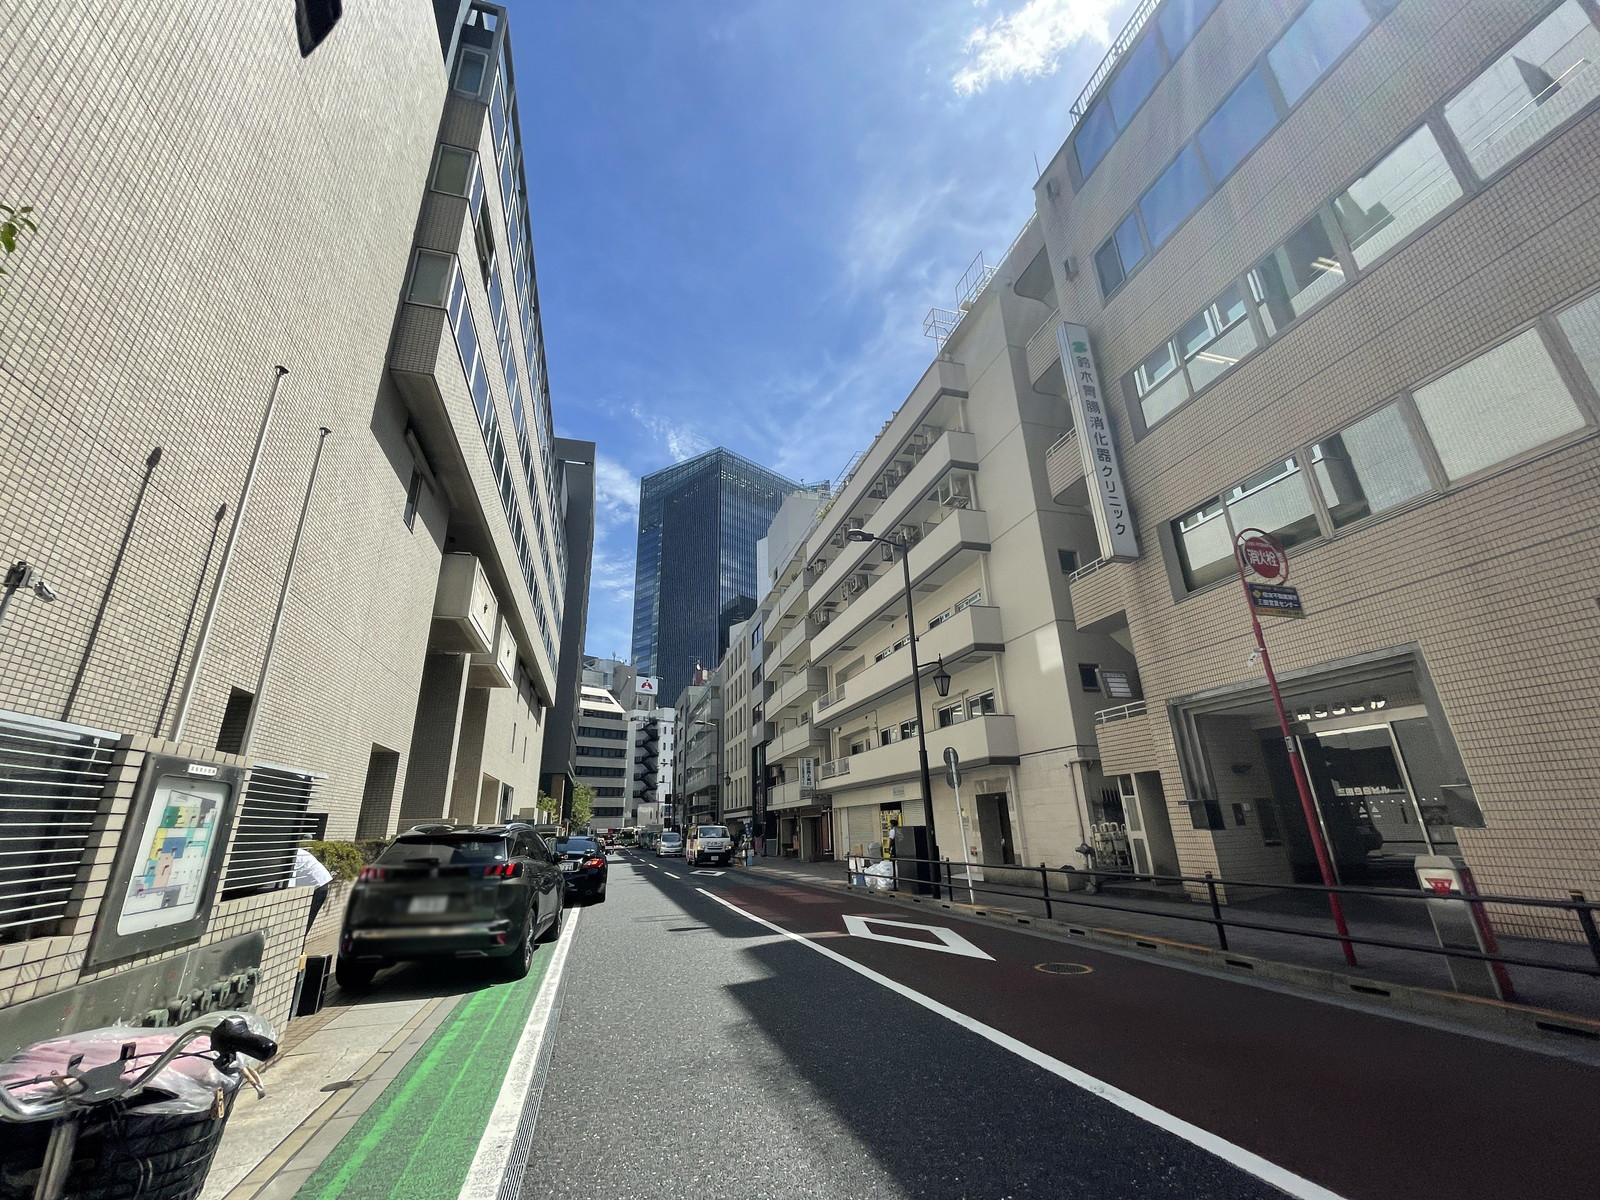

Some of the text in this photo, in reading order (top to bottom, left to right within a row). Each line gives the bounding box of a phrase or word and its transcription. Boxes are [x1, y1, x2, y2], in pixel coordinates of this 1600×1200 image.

[1074, 355, 1126, 536] 鈴木胃腸消化器クリニック
[1246, 548, 1279, 567] 消火栓
